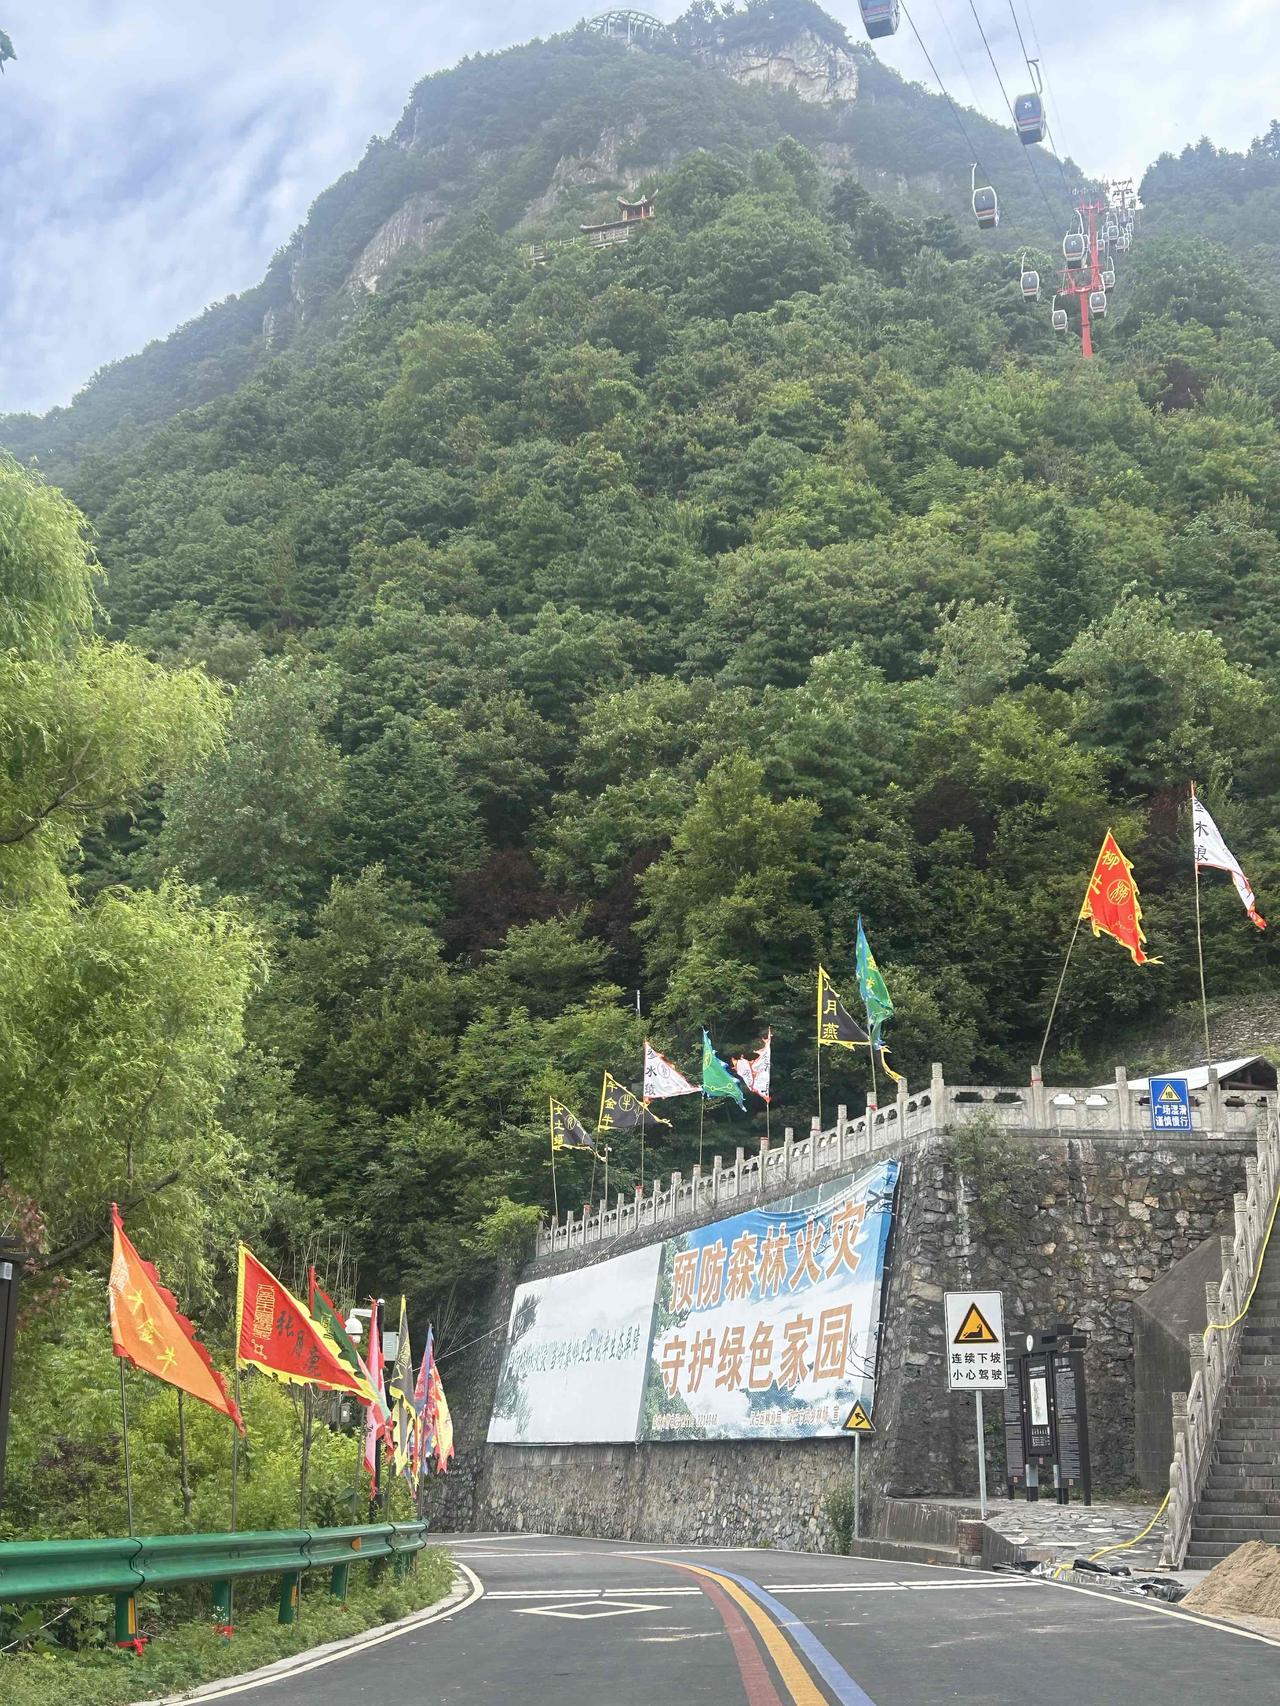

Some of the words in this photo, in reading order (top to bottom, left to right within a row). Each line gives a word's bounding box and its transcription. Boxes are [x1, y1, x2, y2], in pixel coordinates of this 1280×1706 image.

[669, 1199, 867, 1315] 预防森林火灾
[660, 1303, 853, 1399] 守护绿色家园
[951, 1352, 1002, 1364] 连续下坡
[952, 1368, 1003, 1381] 小心驾驶
